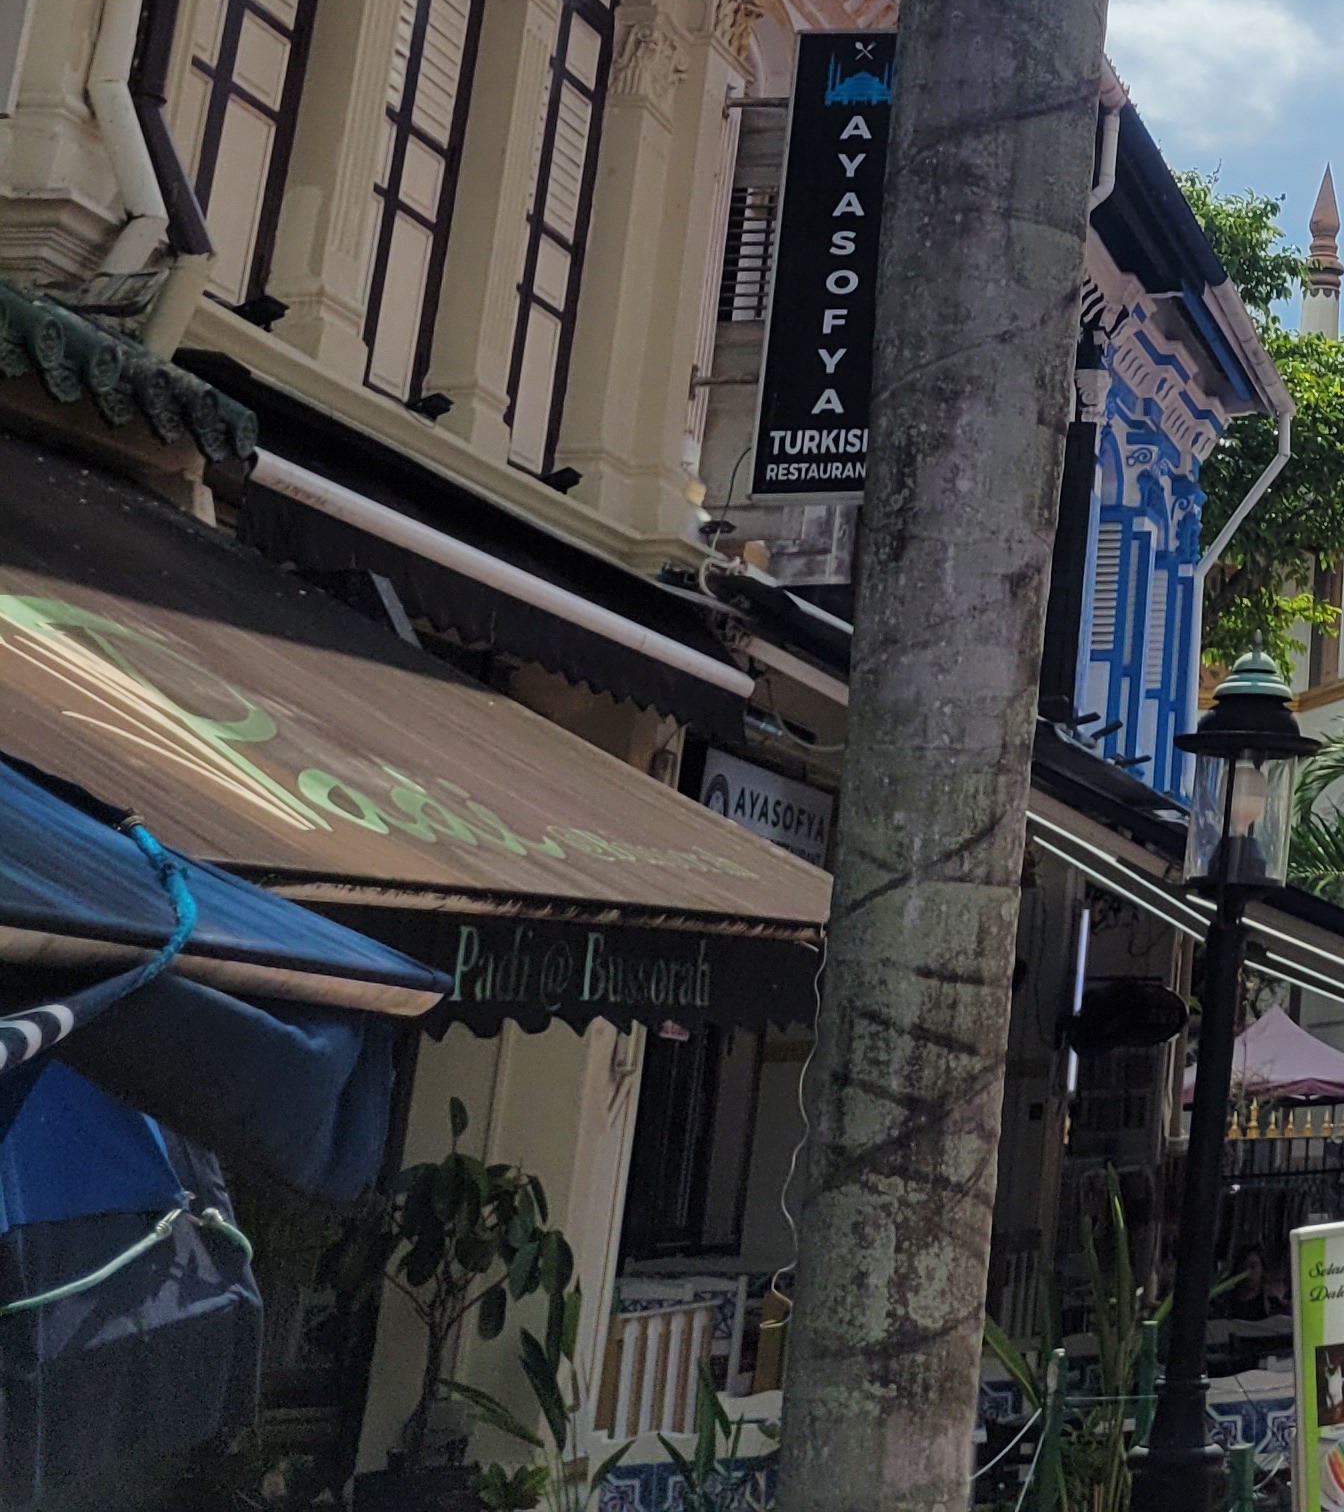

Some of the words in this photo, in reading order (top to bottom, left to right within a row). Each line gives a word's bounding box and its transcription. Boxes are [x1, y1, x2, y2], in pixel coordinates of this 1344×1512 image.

[811, 115, 872, 415] AYASOFYA
[766, 462, 866, 481] RESTAURAN
[735, 787, 825, 844] AYASOFYA
[450, 925, 534, 1002] Padi
[540, 939, 573, 1012] @
[579, 931, 711, 1008] Bussorah
